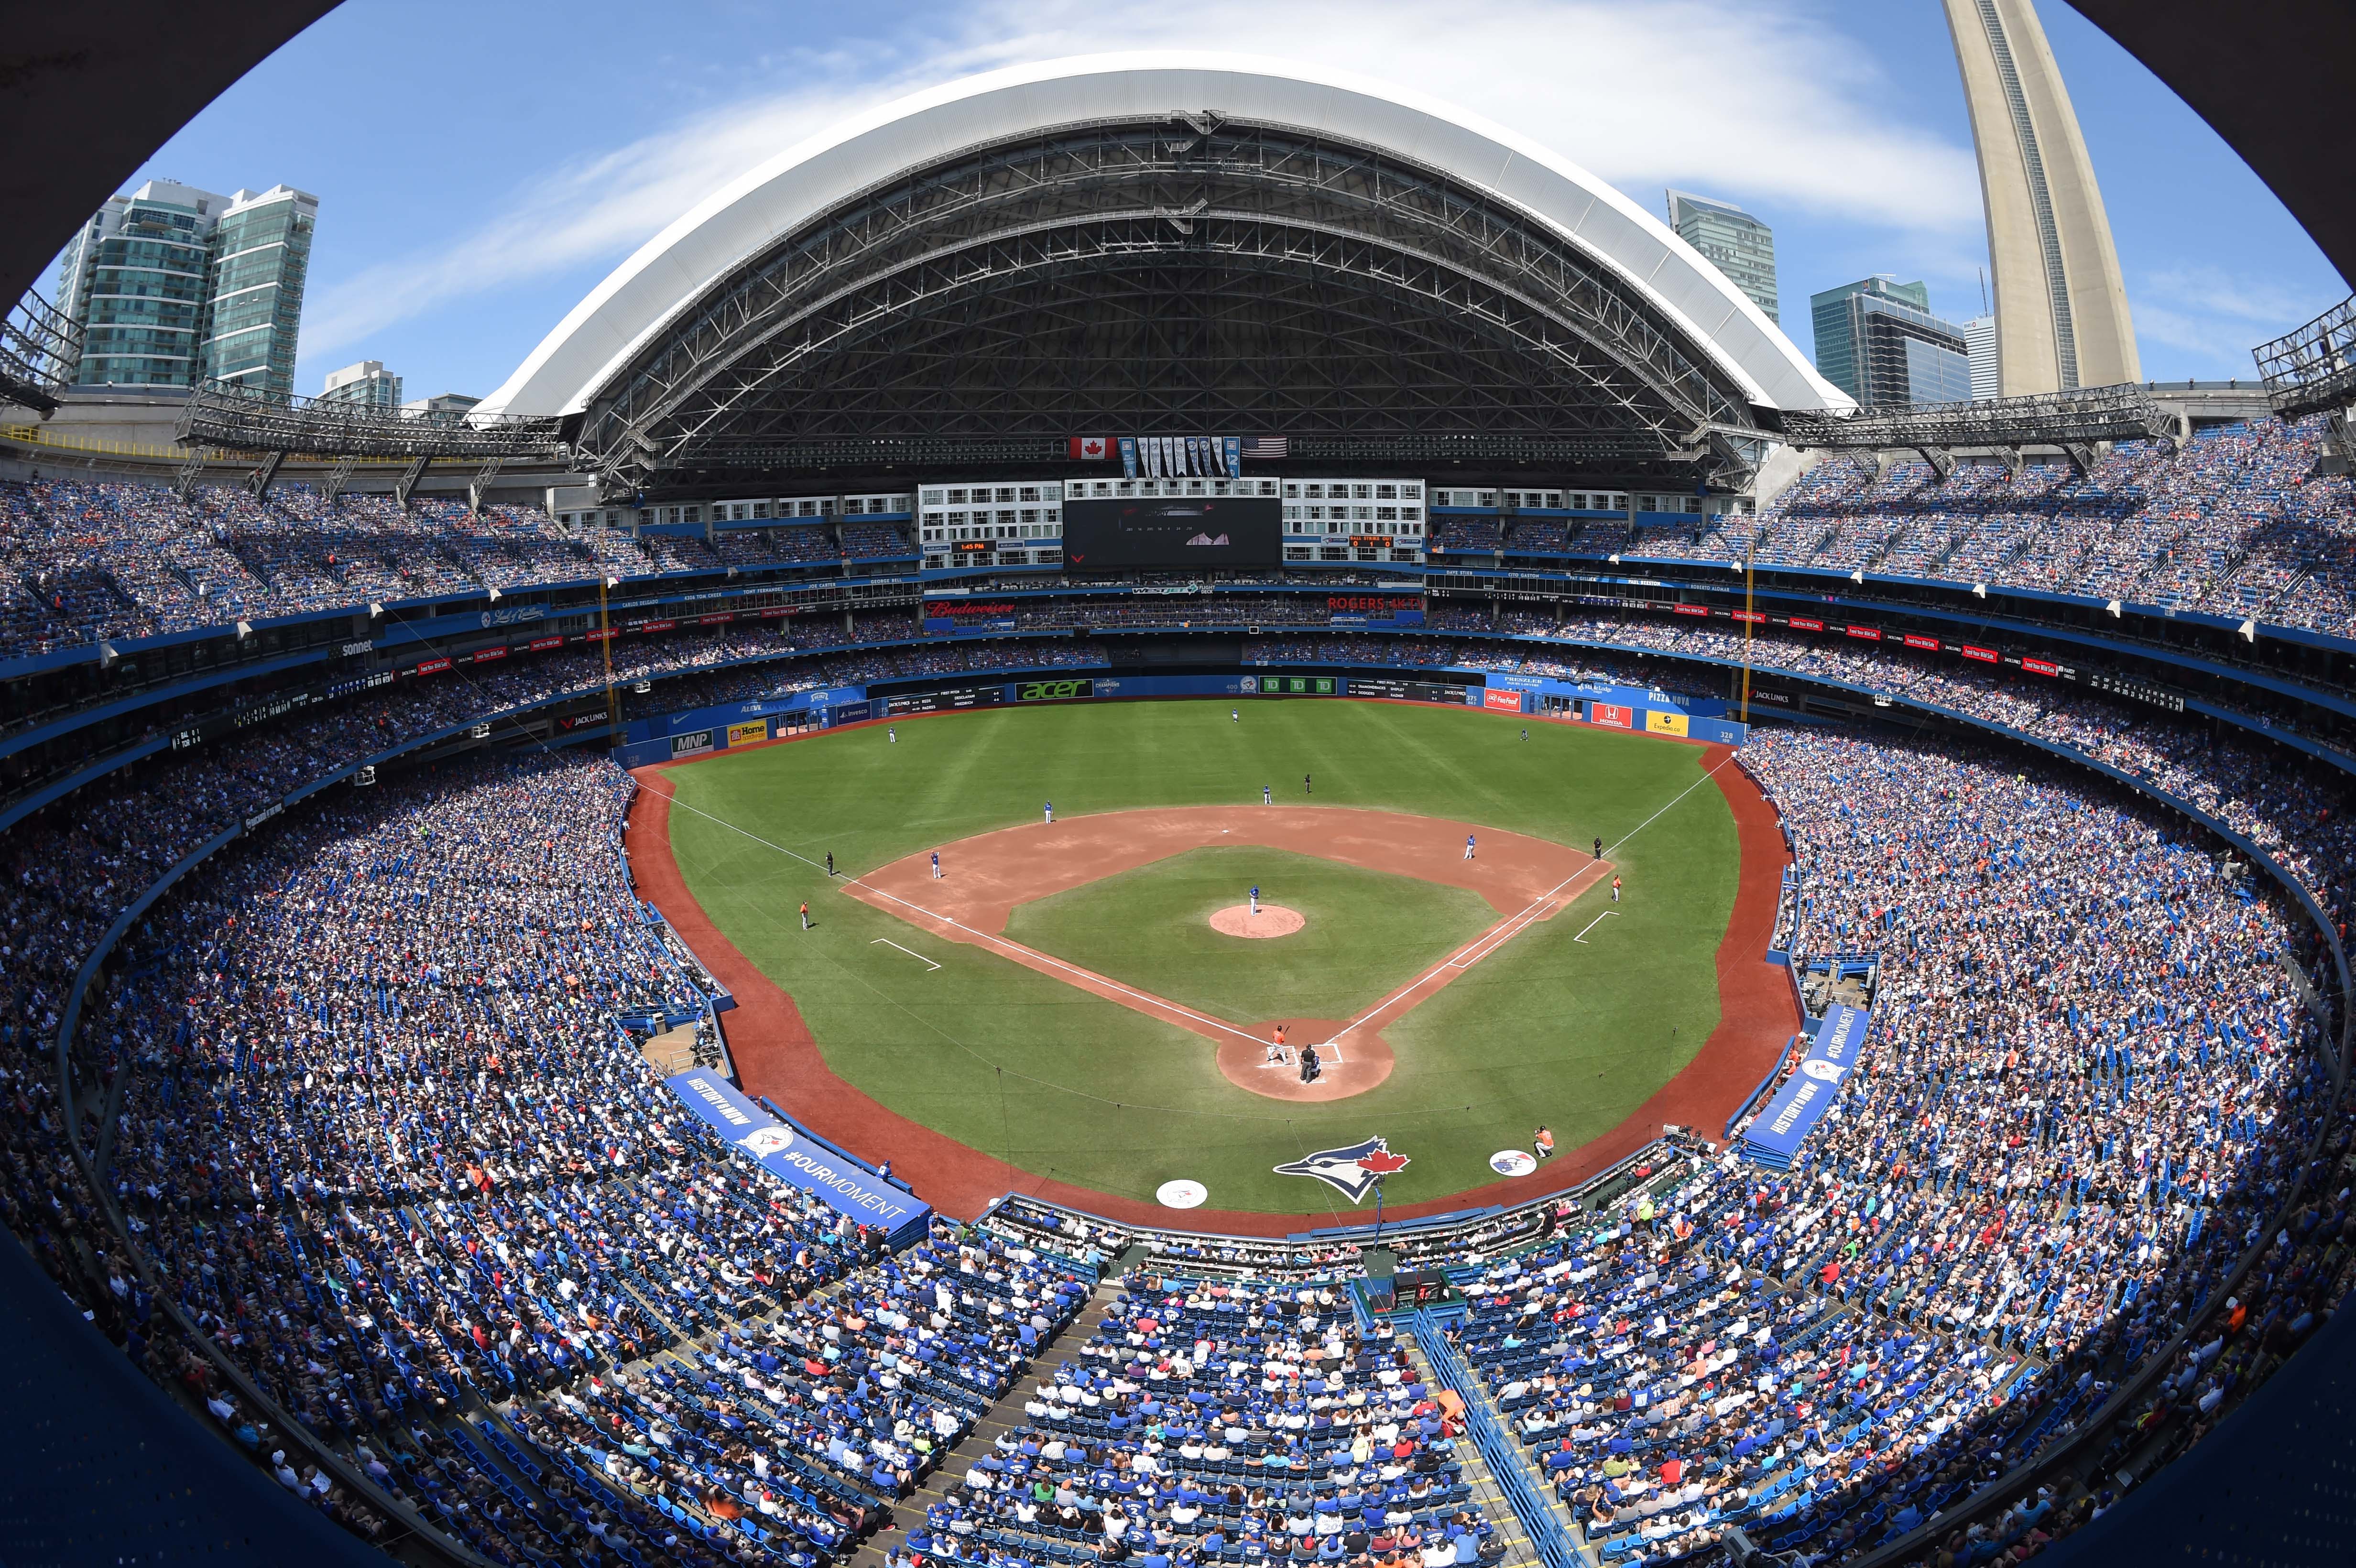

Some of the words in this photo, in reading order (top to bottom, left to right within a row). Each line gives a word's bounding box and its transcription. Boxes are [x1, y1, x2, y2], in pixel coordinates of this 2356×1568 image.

[1226, 455, 1238, 465] 12
[927, 601, 1015, 617] Budweiser
[1329, 598, 1385, 610] ROGERS
[1389, 599, 1406, 610] 4K
[1409, 599, 1426, 610] TV
[343, 639, 372, 656] sonnet
[1022, 680, 1086, 699] acer
[1266, 680, 1278, 689] TD
[1292, 681, 1304, 689] TD
[1318, 681, 1330, 690] TD
[1648, 692, 1670, 703] PIZZA
[1673, 695, 1690, 707] NOVA
[1756, 690, 1770, 700] JACK
[741, 704, 763, 713] ALEVE
[848, 708, 868, 717] invesco
[575, 715, 590, 726] JACK
[742, 725, 765, 735] Home
[1654, 723, 1680, 732] Expedia.ca
[742, 732, 765, 741] hardware
[1720, 731, 1733, 739] 328
[182, 739, 190, 748] TOR
[677, 734, 708, 751] MNP
[627, 755, 639, 763] 328
[1826, 1007, 1856, 1059] #OURMOMENT
[1796, 1080, 1819, 1101] NOW
[687, 1078, 728, 1105] HISTORY
[719, 1107, 752, 1125] NOW
[1770, 1100, 1804, 1135] HISTORY
[783, 1151, 907, 1220] #OURMOMENT
[1653, 1389, 1660, 1398] 11
[1101, 1479, 1109, 1487] 6
